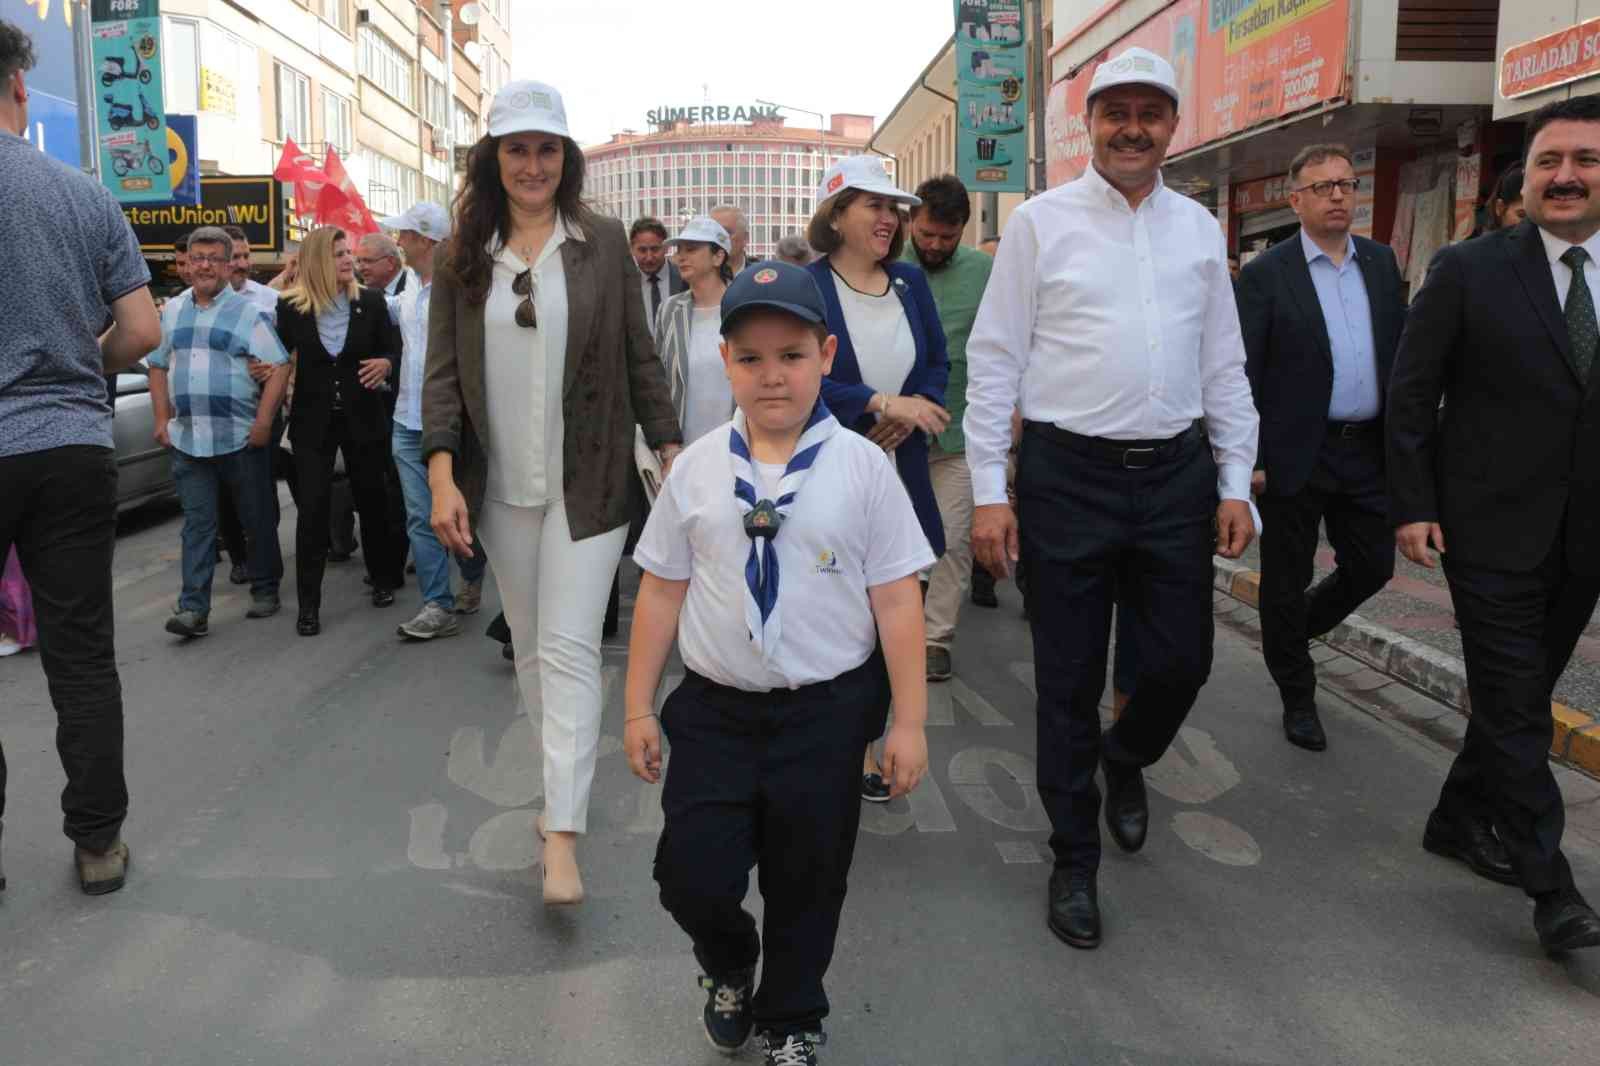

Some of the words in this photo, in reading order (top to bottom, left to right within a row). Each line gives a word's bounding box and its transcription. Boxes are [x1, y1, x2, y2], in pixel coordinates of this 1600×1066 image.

[1504, 39, 1580, 84] TARLADAN
[646, 104, 781, 125] SÜMERBANK
[234, 205, 268, 224] WU
